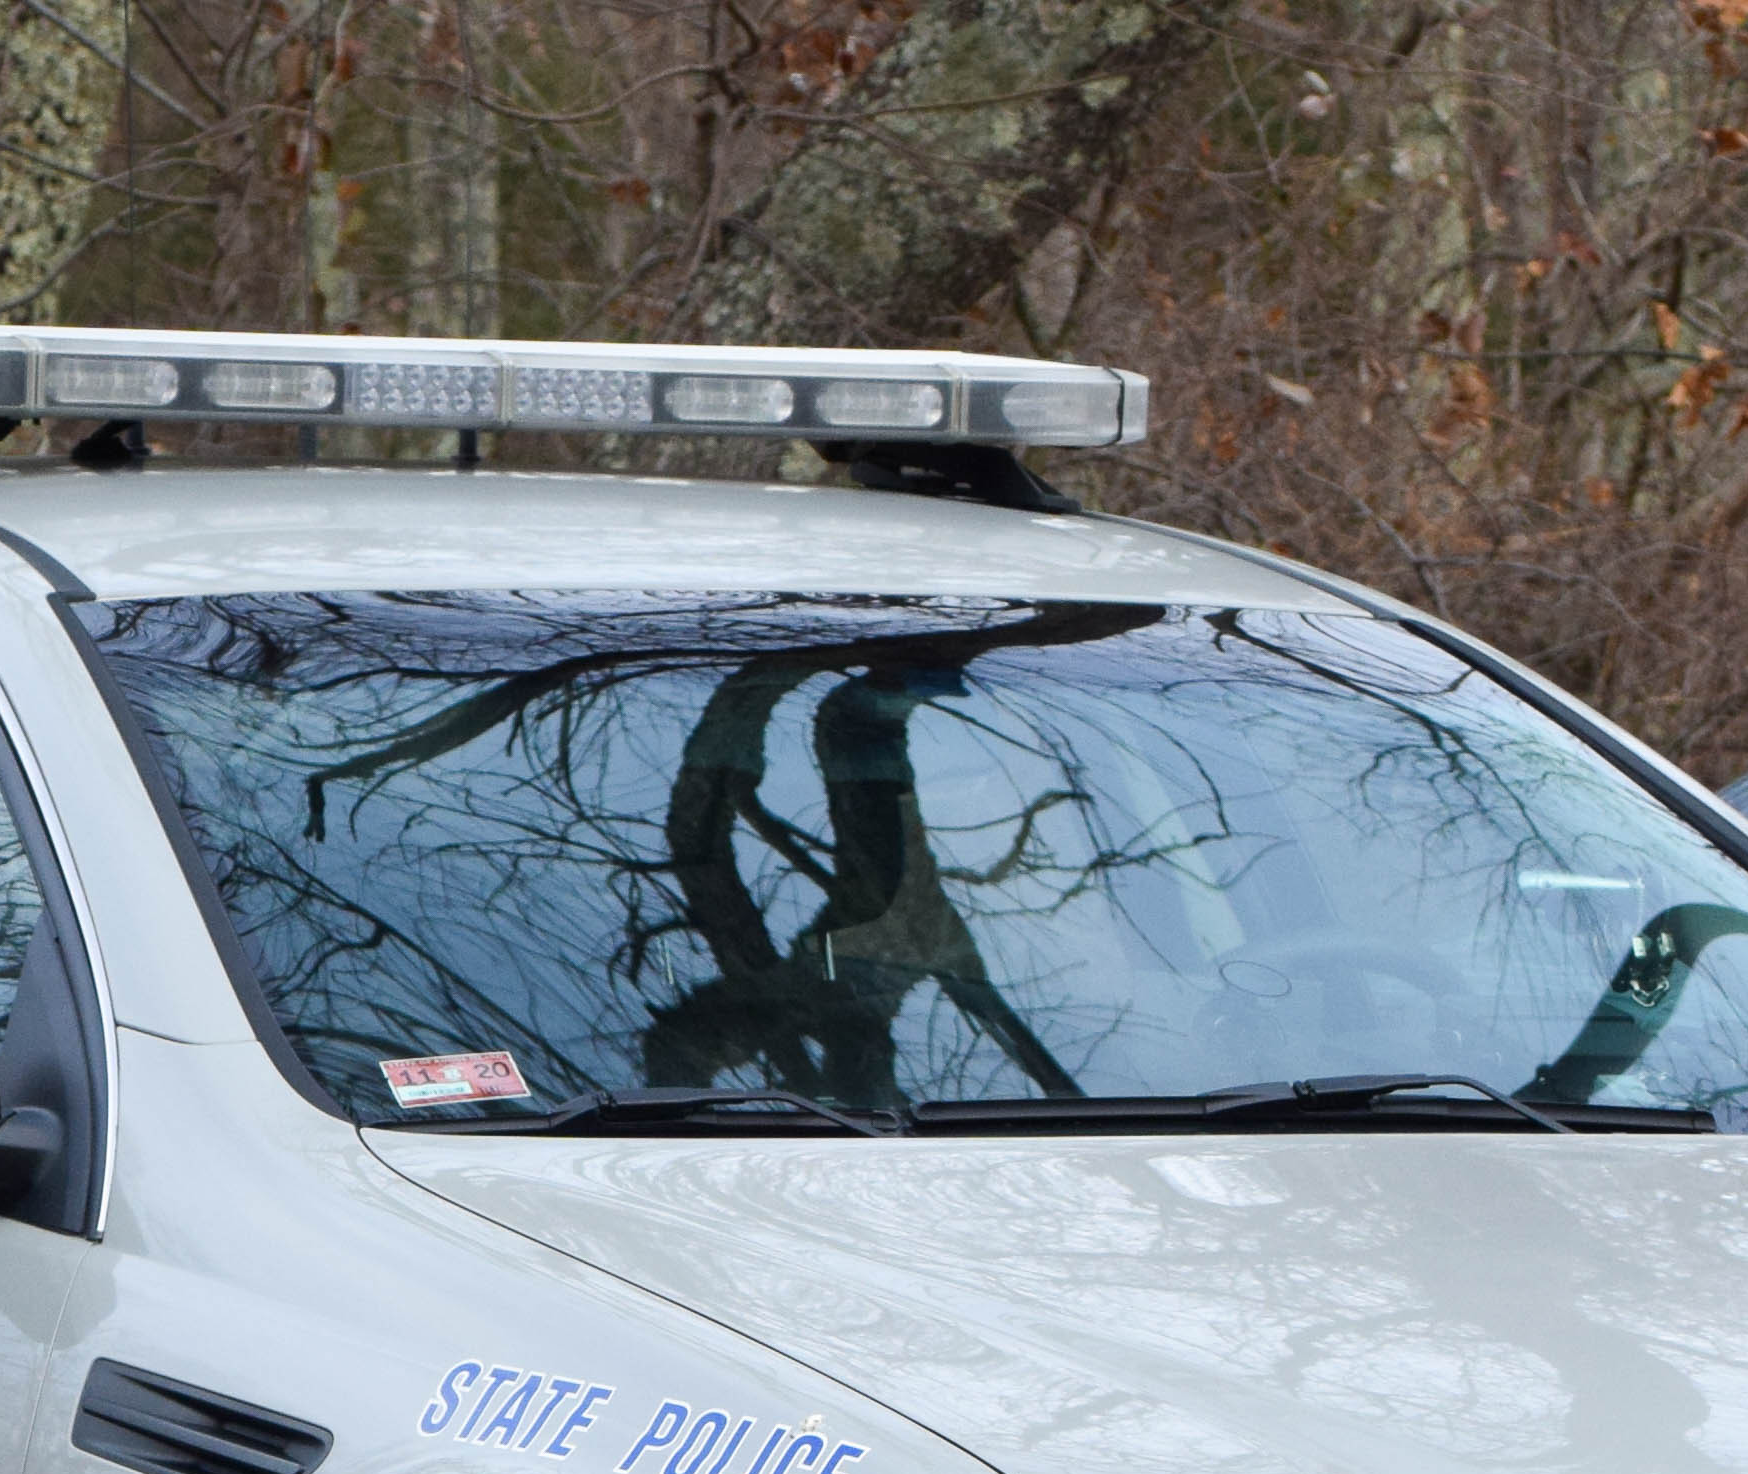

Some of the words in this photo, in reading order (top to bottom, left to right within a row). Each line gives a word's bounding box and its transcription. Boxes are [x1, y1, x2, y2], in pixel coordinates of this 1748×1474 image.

[399, 1067, 438, 1087] 11
[473, 1060, 511, 1080] 20
[416, 1358, 617, 1462] STATE
